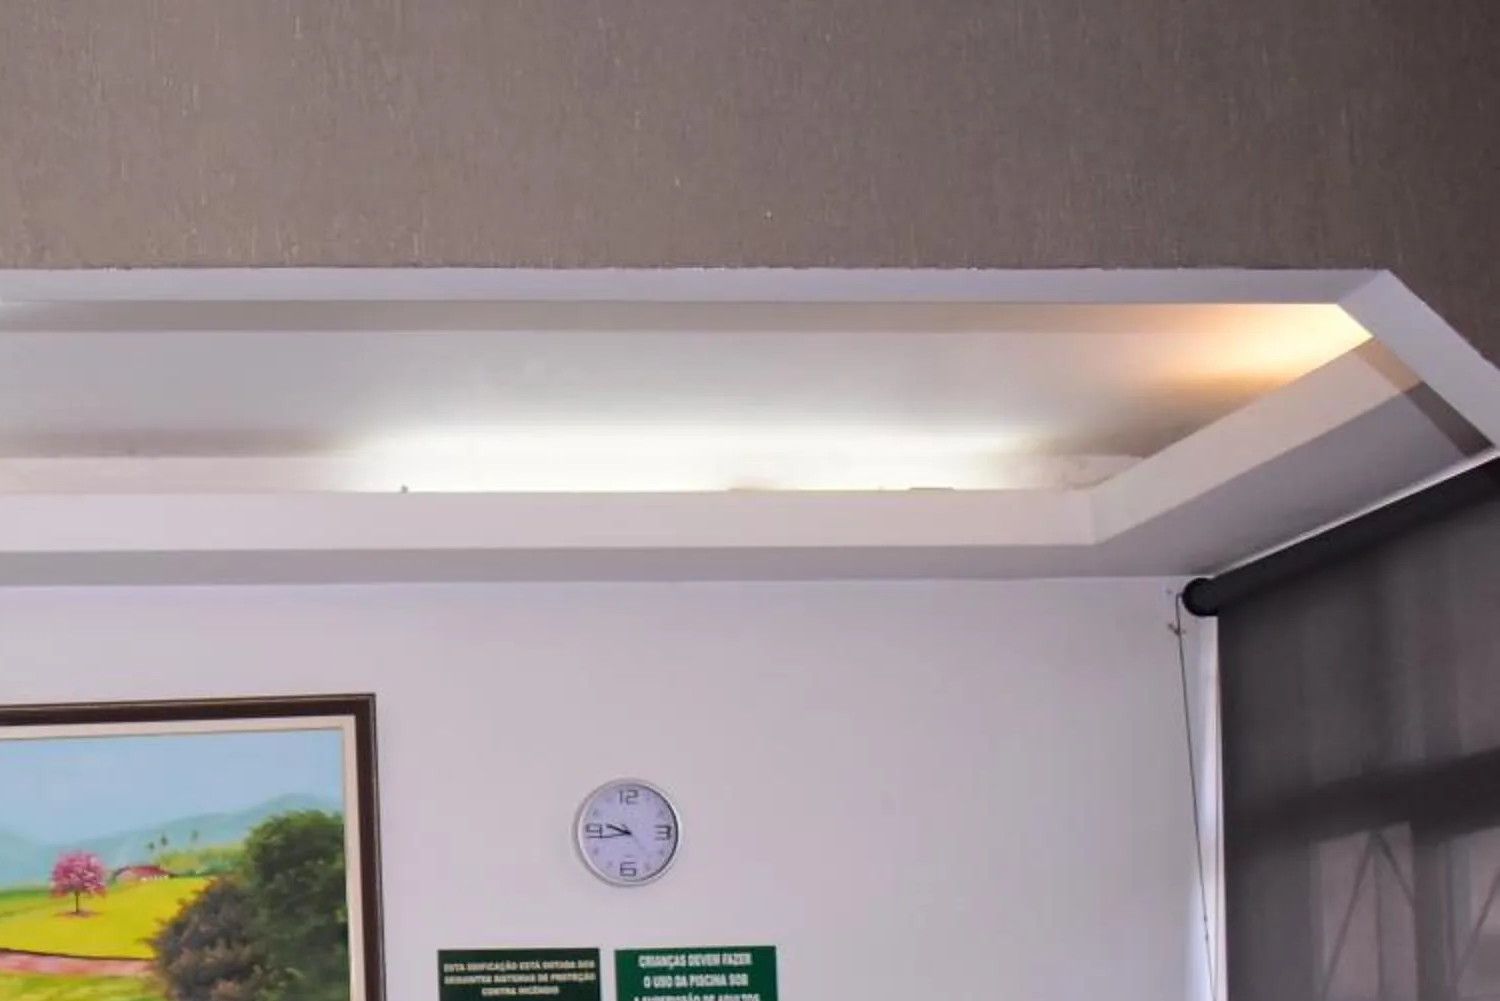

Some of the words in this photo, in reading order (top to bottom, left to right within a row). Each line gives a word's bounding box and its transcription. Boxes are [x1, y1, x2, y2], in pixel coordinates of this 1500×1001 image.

[619, 789, 639, 805] 12
[585, 823, 603, 839] 9
[654, 824, 671, 841] 3
[620, 861, 637, 877] 6
[638, 954, 686, 969] CRIANÇAS
[721, 952, 753, 966] FAZER
[643, 975, 651, 989] O
[652, 975, 673, 988] USO
[674, 975, 687, 988] DA
[689, 973, 727, 987] PISCINA
